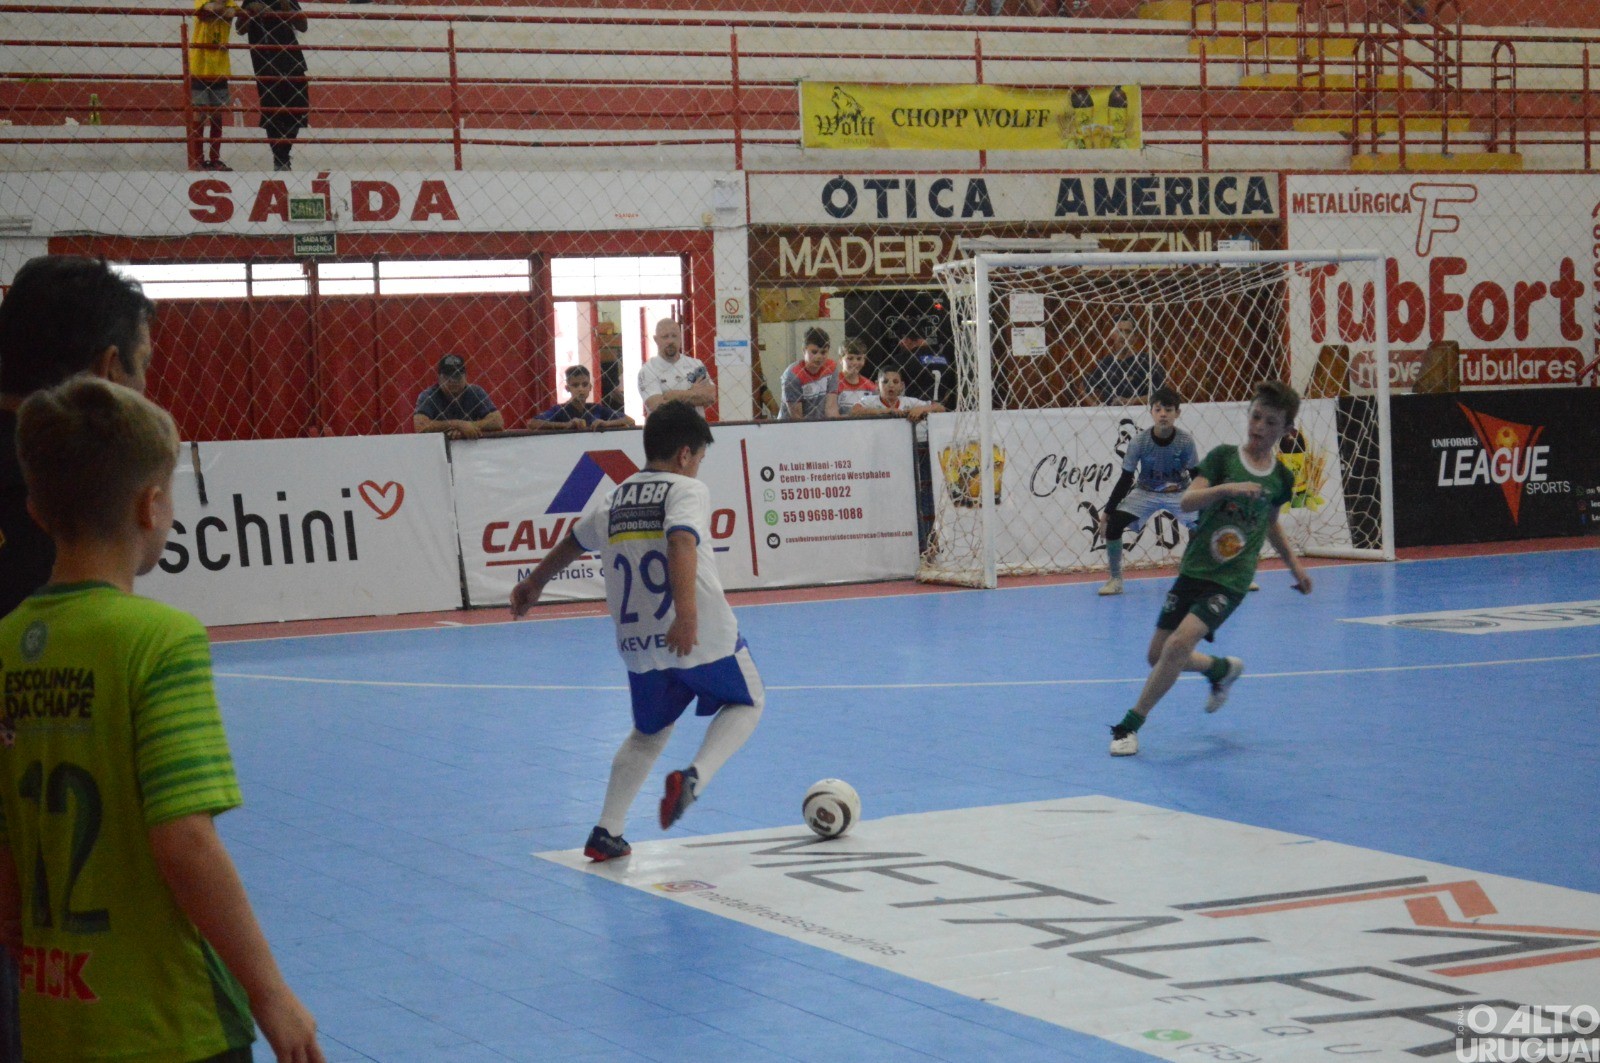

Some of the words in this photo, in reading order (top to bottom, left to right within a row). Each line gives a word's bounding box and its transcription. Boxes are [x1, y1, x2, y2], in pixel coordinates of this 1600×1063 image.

[891, 107, 969, 127] CHOPP
[973, 107, 1050, 128] WOLFF
[188, 171, 460, 223] SAÍDA
[821, 174, 995, 219] ÓTICA
[1054, 173, 1275, 217] AMÉRICA
[1292, 186, 1412, 214] METALÚRGICA
[779, 235, 1000, 276] MADEIRA
[1295, 257, 1585, 344] TubFort
[1432, 437, 1478, 448] UNIFORMES
[779, 462, 789, 472] Av.
[791, 461, 805, 471] Luiz
[806, 460, 830, 471] Milani
[835, 460, 852, 469] 1623
[780, 474, 806, 483] Centro
[811, 472, 846, 481] Frederico
[847, 470, 891, 480] Westphalen
[1030, 453, 1113, 498] Chopp
[1438, 445, 1550, 487] LEAGUE
[612, 483, 669, 509] AABB
[781, 488, 794, 500] 55
[797, 486, 851, 500] 2010-0022
[1526, 480, 1571, 495] SPORTS
[783, 511, 797, 523] 55
[799, 510, 805, 522] 9
[807, 507, 863, 522] 9698-1088
[517, 565, 594, 583] Meriais
[613, 550, 673, 624] 29
[620, 633, 668, 652] KEVE
[4, 668, 95, 693] ESCOLINHA
[33, 690, 94, 718] CHAPE
[19, 761, 110, 933] 12
[20, 945, 100, 1002] FISK
